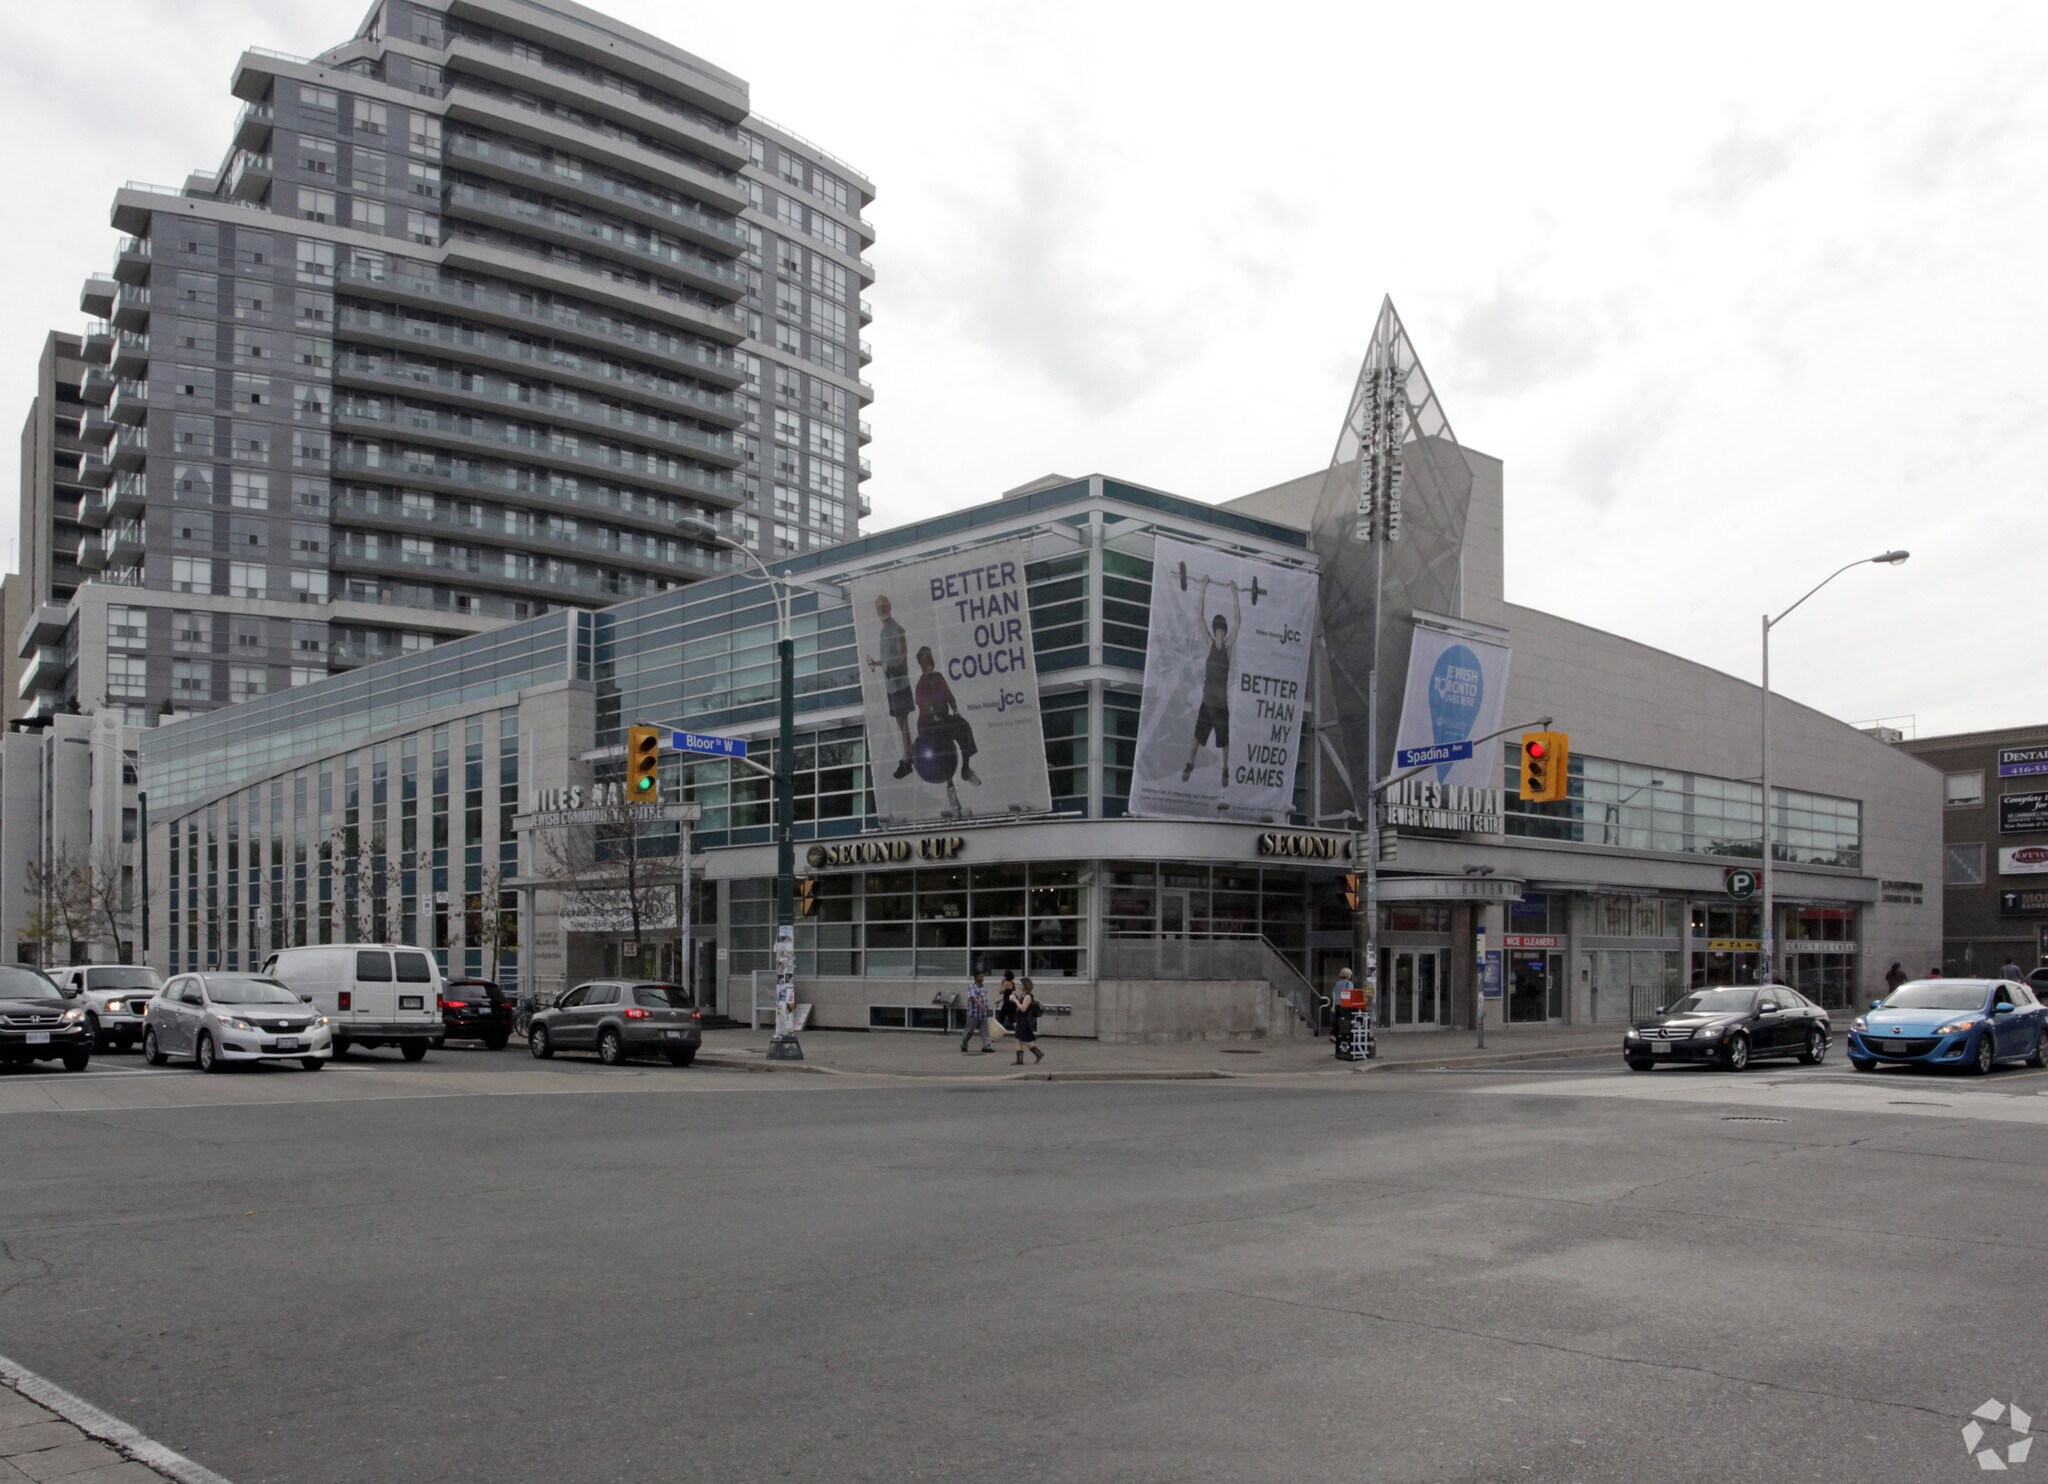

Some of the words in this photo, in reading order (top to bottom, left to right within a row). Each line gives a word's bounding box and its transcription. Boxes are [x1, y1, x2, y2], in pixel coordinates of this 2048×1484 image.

[1360, 367, 1376, 449] Theatre
[1390, 395, 1407, 456] Green
[1357, 455, 1373, 515] Green
[1388, 461, 1406, 541] Theatre
[1357, 521, 1371, 541] Al
[930, 561, 1017, 601] BETTER
[955, 590, 1019, 623] THAN
[974, 619, 1023, 648] OUR
[1280, 623, 1301, 645] jcc
[948, 647, 1025, 681] COUCH
[1447, 664, 1479, 683] JEWISH
[1240, 673, 1298, 700] BETTER
[1434, 677, 1478, 698] TORONTO
[998, 688, 1025, 712] jcc
[1256, 699, 1295, 722] THAN
[686, 735, 715, 750] Bloor
[724, 739, 734, 752] W
[1270, 724, 1292, 743] MY
[1247, 743, 1288, 766] VIDEO
[1406, 747, 1450, 765] Spadina
[1452, 745, 1463, 755] Ave
[1235, 766, 1285, 788] GAMES
[529, 785, 582, 812] MILES
[1387, 777, 1442, 809] MILES
[1448, 783, 1503, 816] NADAL
[2004, 795, 2042, 805] Complete
[1388, 806, 1420, 827] JEWISH
[1422, 810, 1471, 832] COMMUNITY
[827, 840, 910, 864] SECOND
[916, 836, 962, 860] CUP
[1260, 832, 1341, 858] SECOND
[1733, 875, 1750, 892] P
[1506, 937, 1521, 946] NICE
[1523, 937, 1556, 946] CLEANERS
